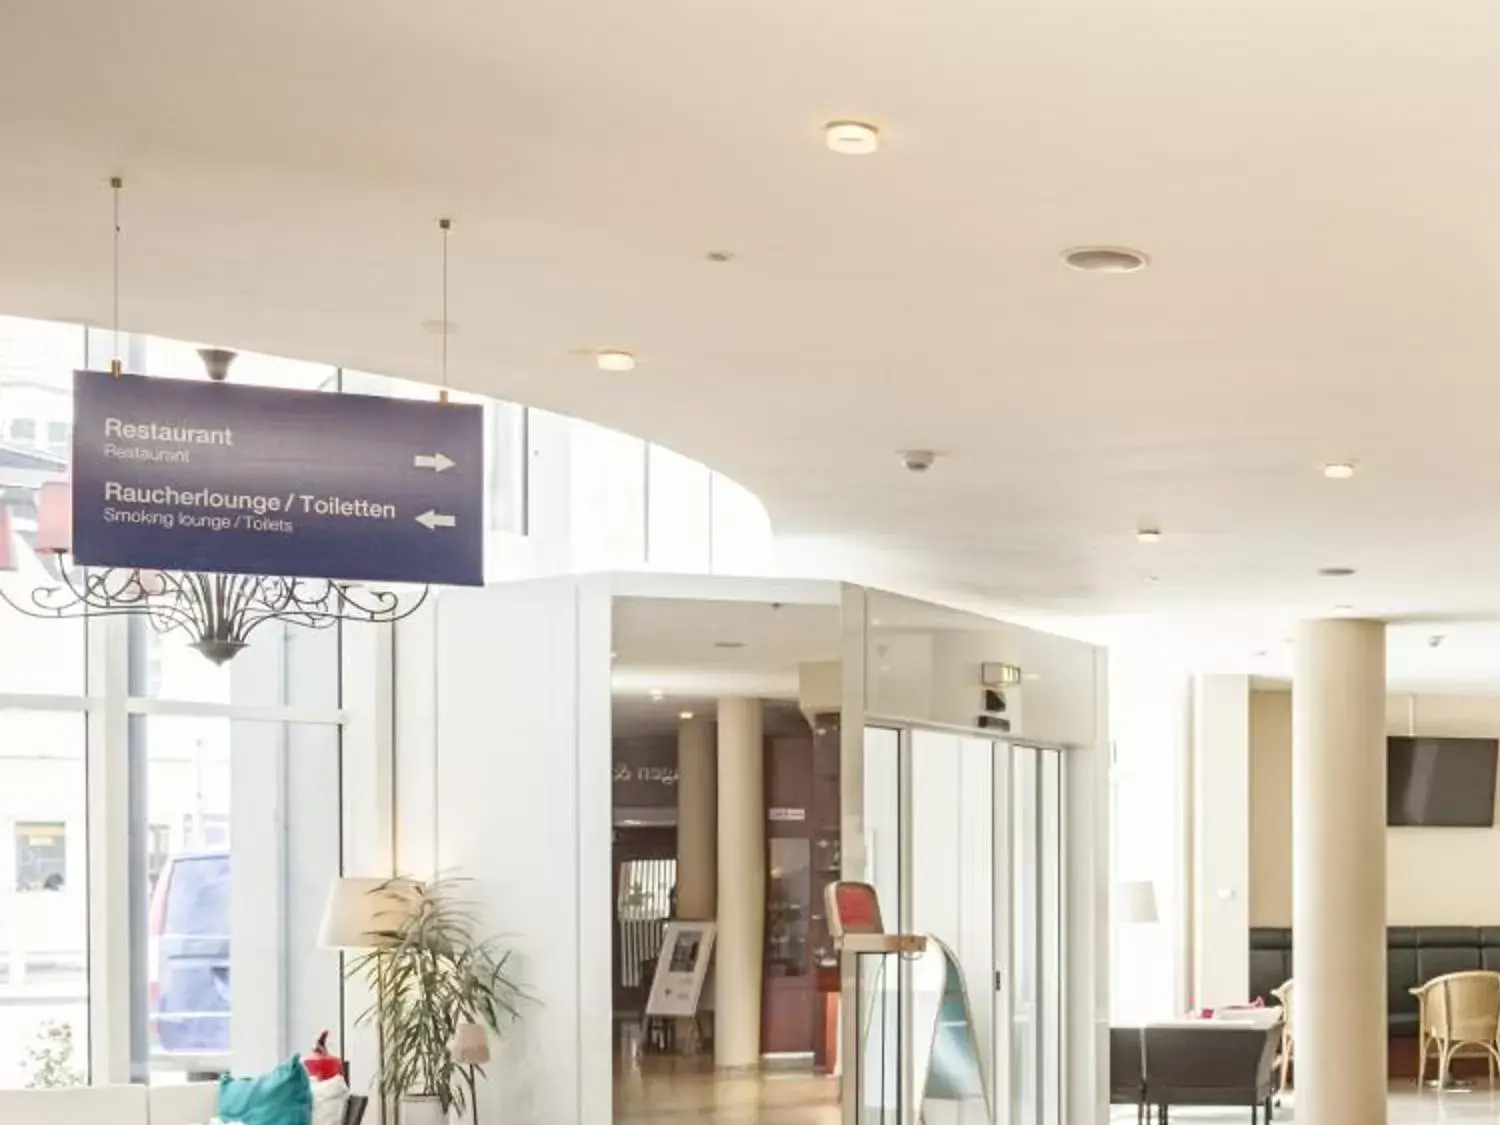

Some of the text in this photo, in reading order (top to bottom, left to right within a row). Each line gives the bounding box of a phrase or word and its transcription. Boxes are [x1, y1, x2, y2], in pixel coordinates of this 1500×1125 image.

[104, 418, 233, 445] Restaurant
[104, 443, 190, 462] Restaurant
[104, 482, 396, 519] Raucherlounge / Toiletten
[103, 507, 174, 528] Smoking
[178, 512, 231, 531] lounge
[244, 515, 294, 533] Toilets
